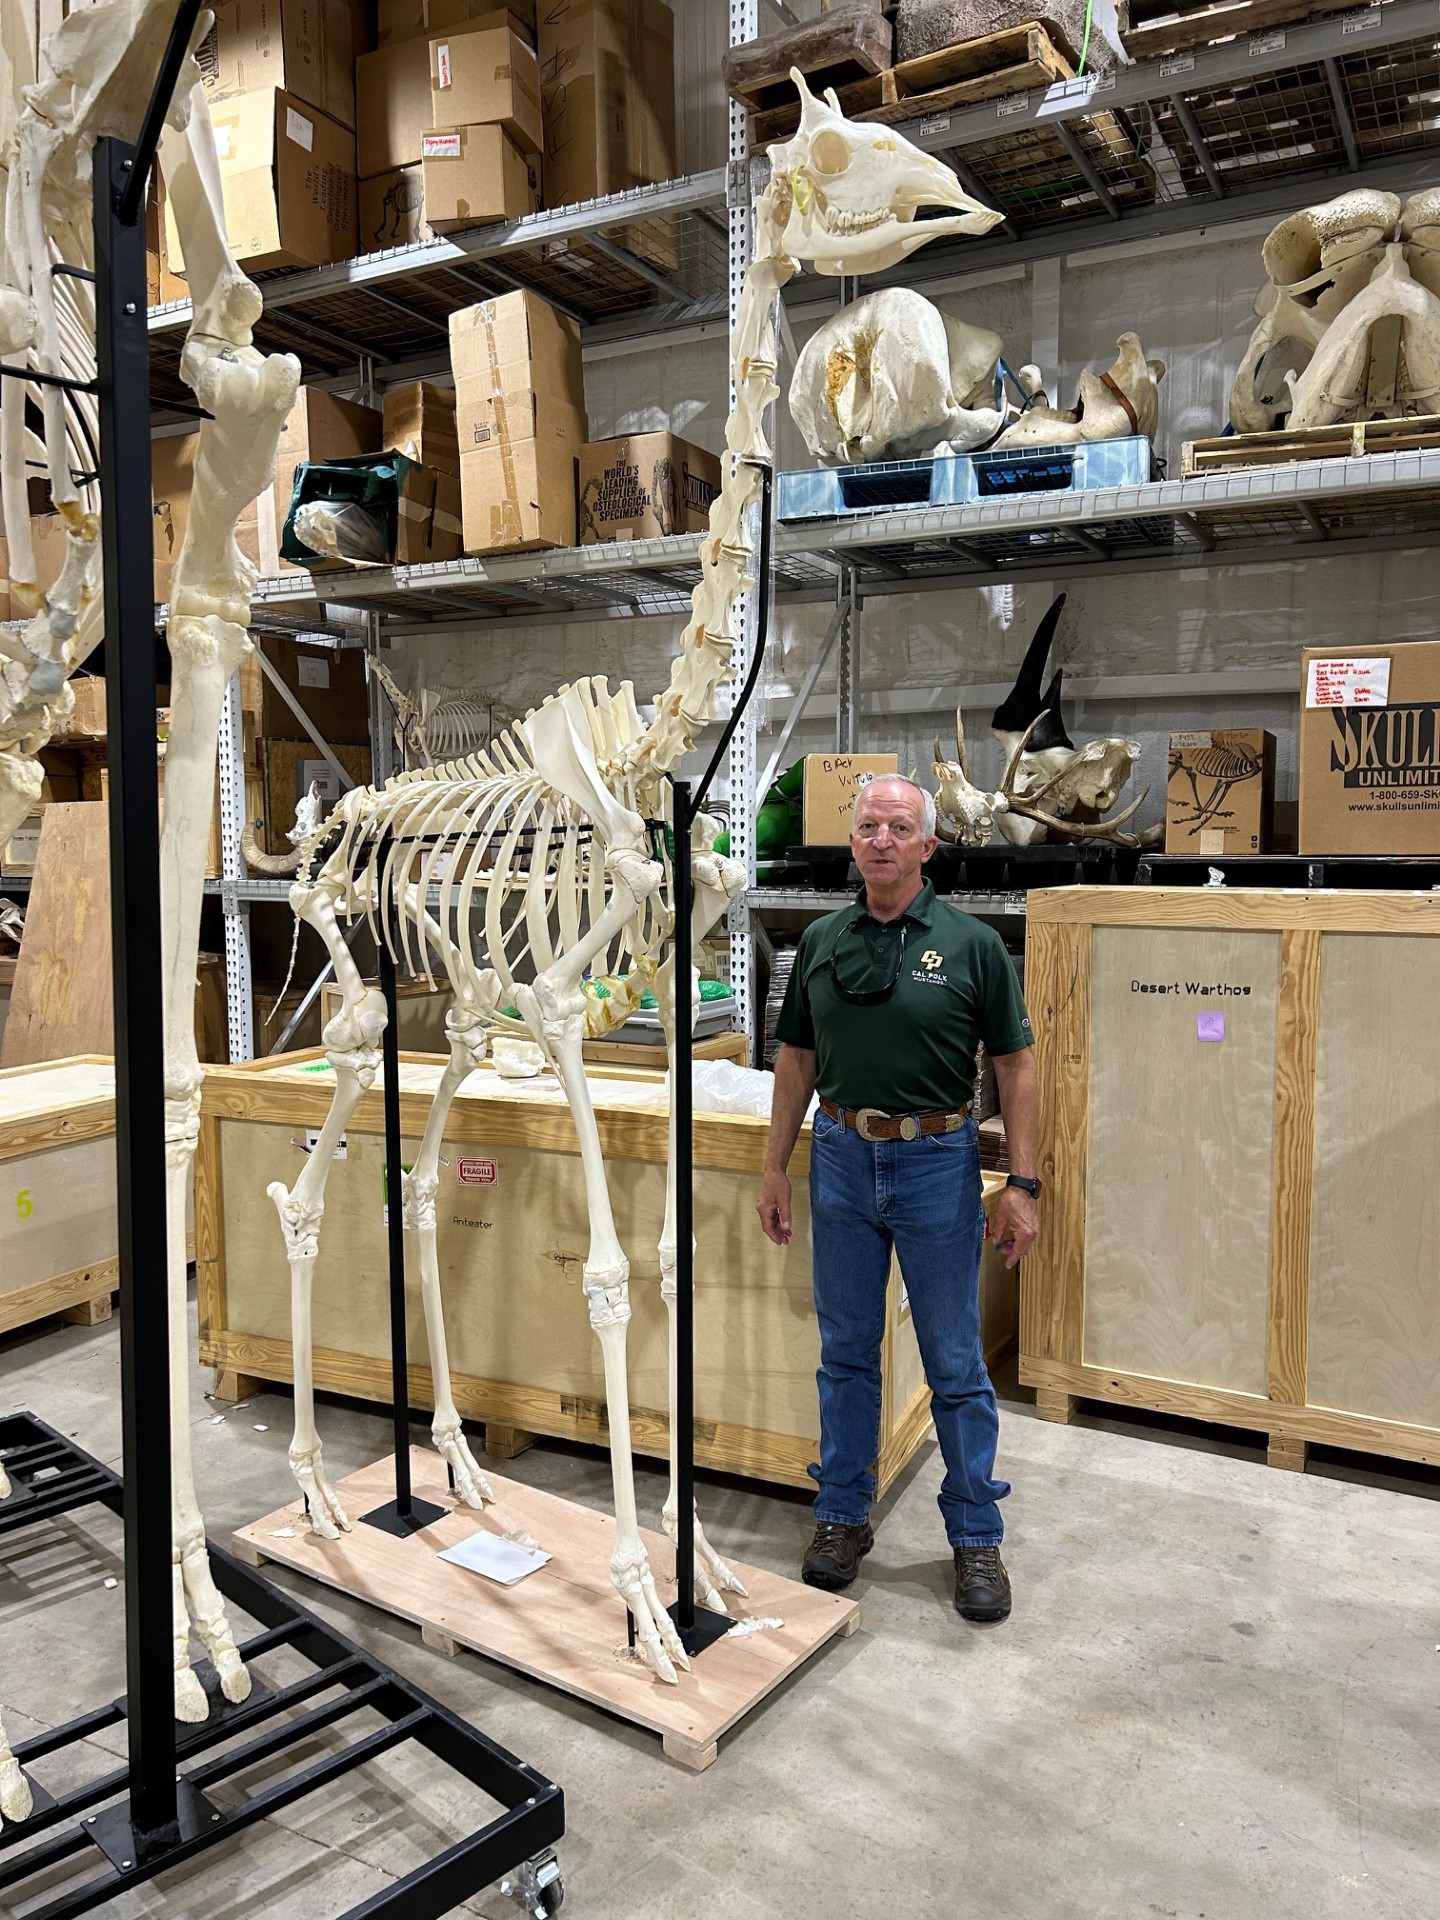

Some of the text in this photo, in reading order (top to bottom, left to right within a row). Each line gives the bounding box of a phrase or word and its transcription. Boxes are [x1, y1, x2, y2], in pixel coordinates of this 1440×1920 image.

[312, 165, 320, 205] World's
[320, 168, 329, 212] Leading
[327, 177, 335, 225] Supplier
[616, 459, 627, 467] THE
[604, 465, 639, 480] WORLD'S
[604, 476, 639, 489] LEADING
[682, 461, 710, 508] SKULLS
[597, 487, 646, 501] SUPPLIER OF
[593, 495, 652, 512] OSTEOLOGICAL
[599, 507, 645, 521] SPECIMENS
[1370, 790, 1440, 800] 1-800-659-SK
[913, 976, 944, 985] MUSTANGS
[928, 972, 947, 981] POLY
[1131, 980, 1251, 995] Desert Warthog
[16, 1188, 33, 1218] 5
[453, 1216, 493, 1229] Anteater
